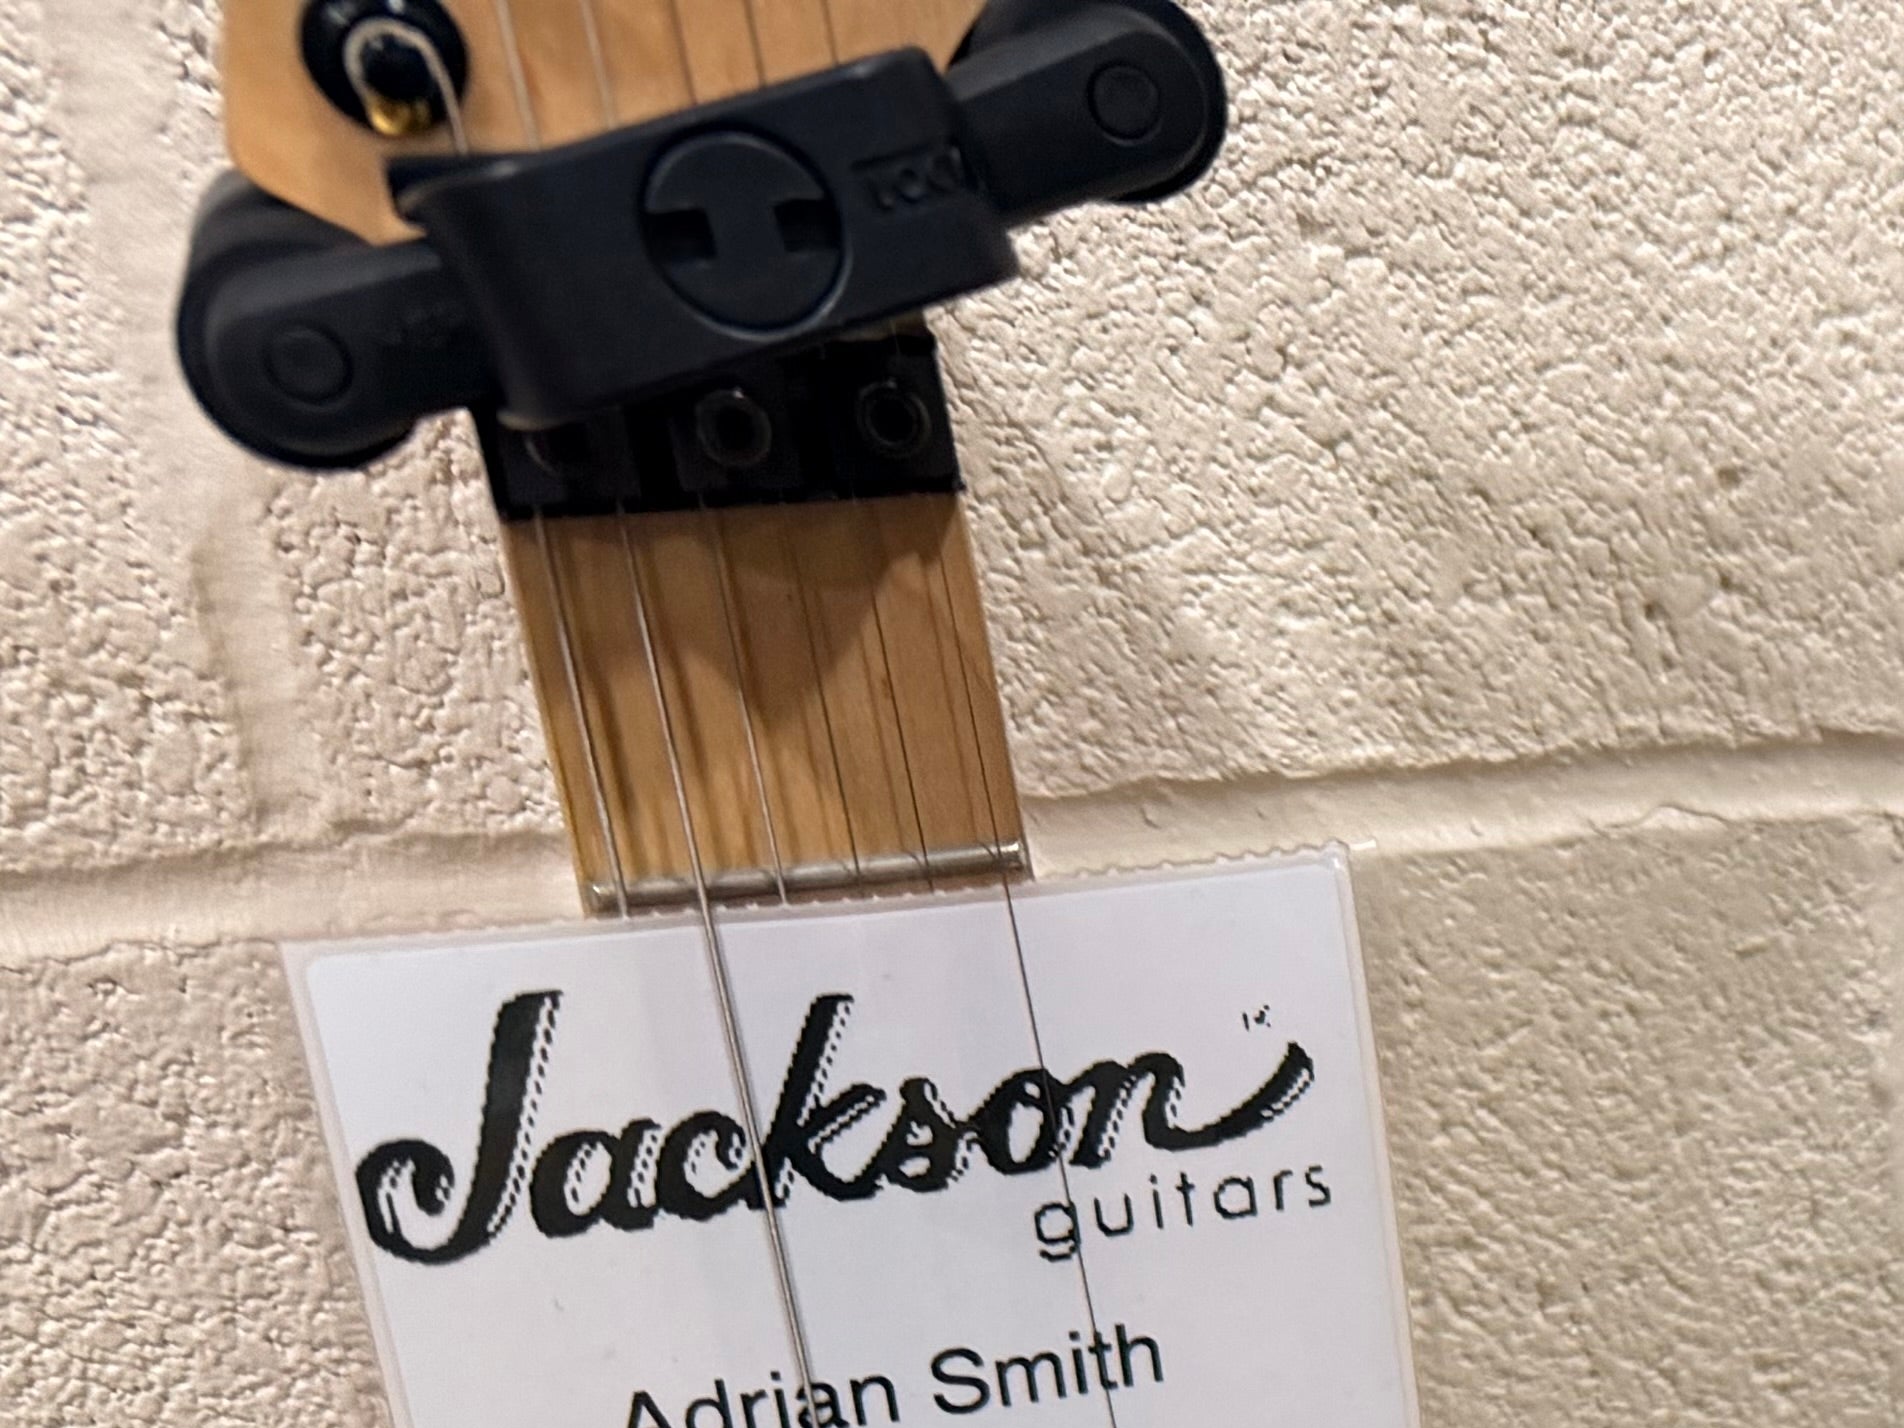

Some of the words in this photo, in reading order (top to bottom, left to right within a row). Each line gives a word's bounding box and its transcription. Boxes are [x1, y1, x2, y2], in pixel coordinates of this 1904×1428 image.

[355, 988, 1316, 1266] Jackson
[1032, 1162, 1332, 1262] guitars
[929, 1322, 1164, 1416] Smith
